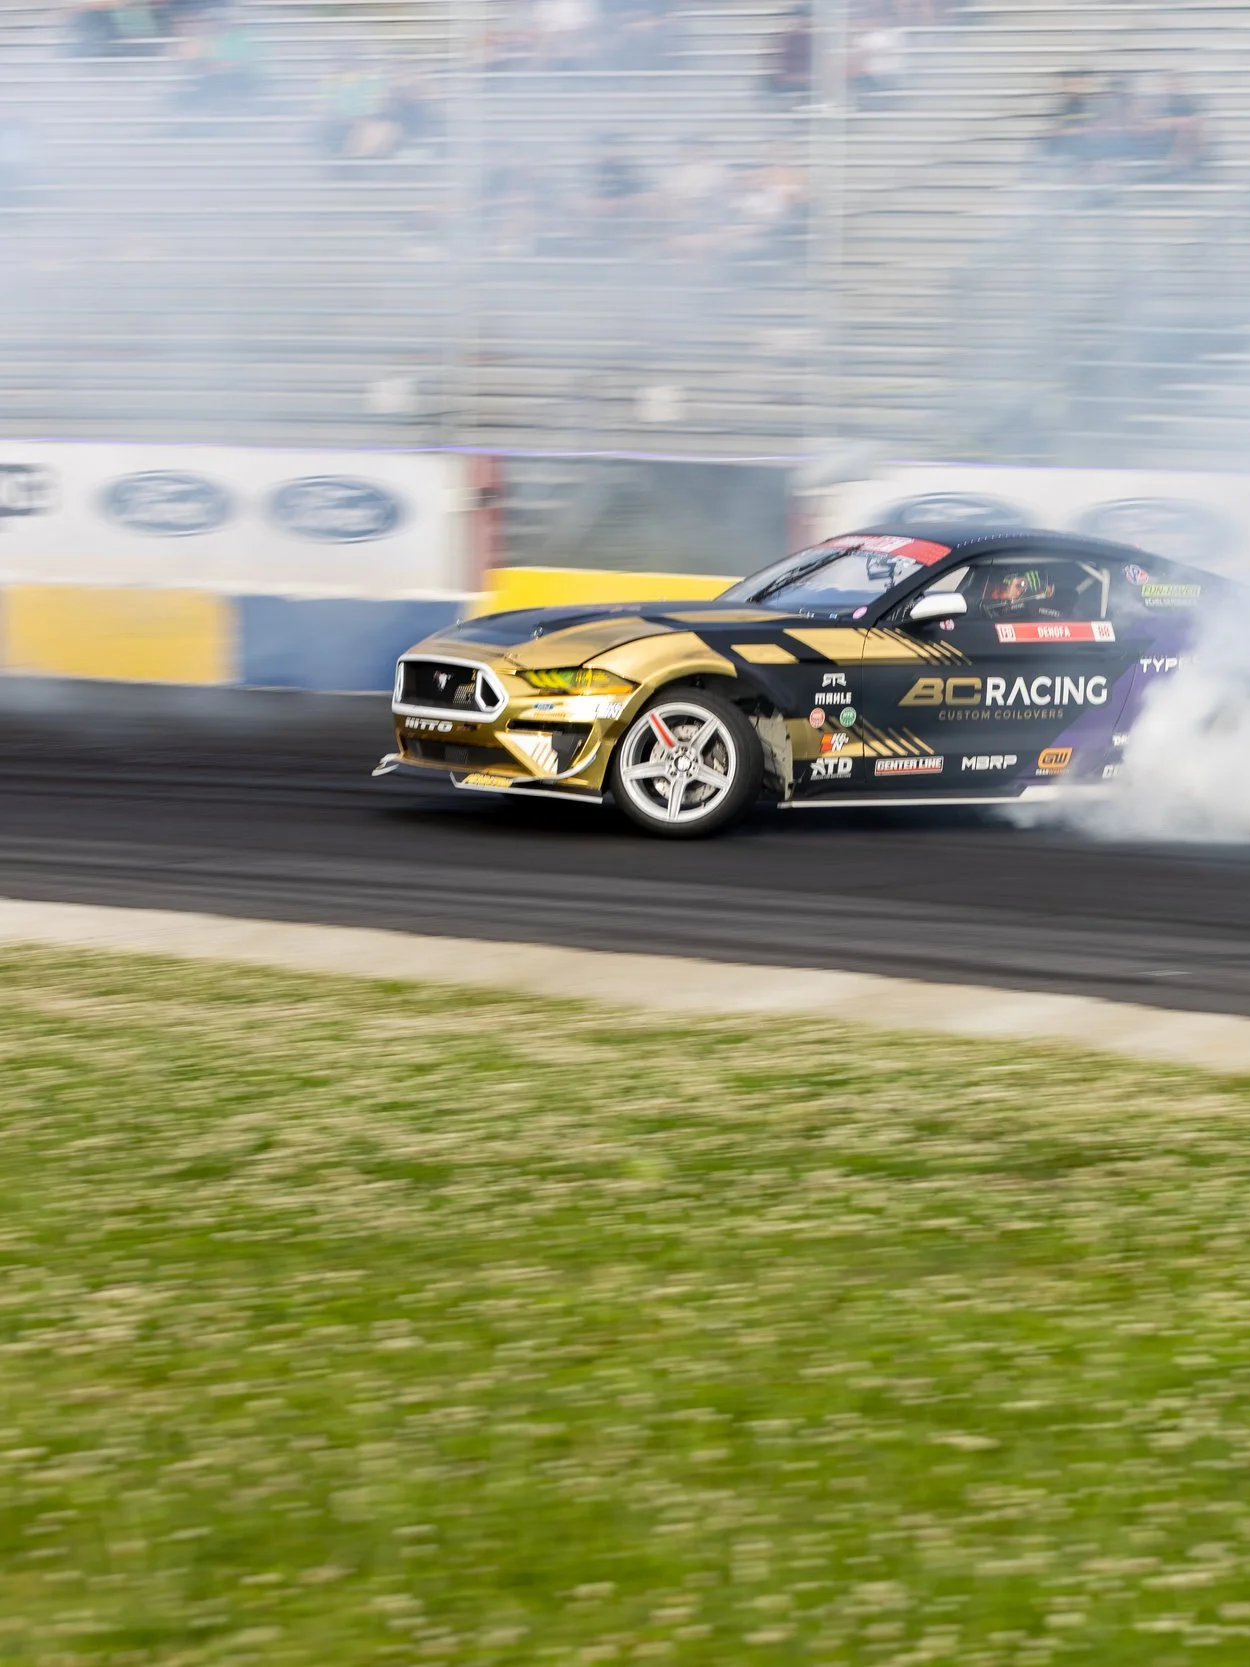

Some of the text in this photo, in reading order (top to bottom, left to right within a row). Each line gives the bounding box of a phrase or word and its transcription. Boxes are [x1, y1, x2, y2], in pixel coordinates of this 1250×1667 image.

[985, 675, 1108, 707] RACING
[815, 692, 852, 705] MAHLE
[938, 708, 1064, 721] CUSTOM COILOVERS
[405, 716, 453, 733] NITTO
[877, 758, 942, 771] CENTER LINE
[961, 755, 1018, 771] MBRP
